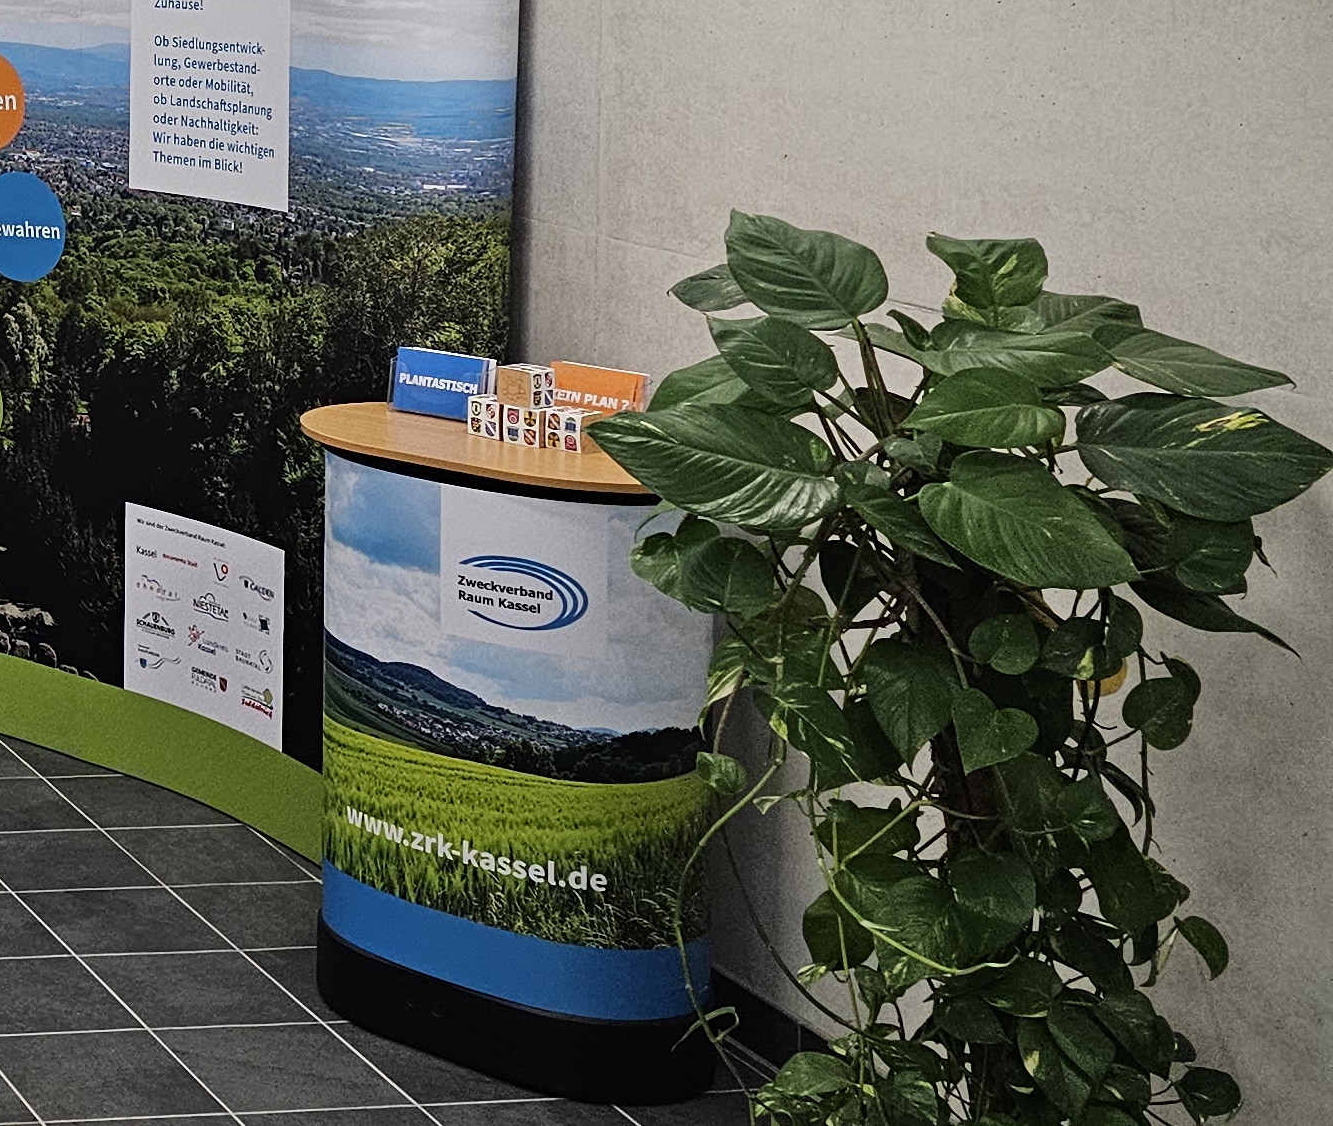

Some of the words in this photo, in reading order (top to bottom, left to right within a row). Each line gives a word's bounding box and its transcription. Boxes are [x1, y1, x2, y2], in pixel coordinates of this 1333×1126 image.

[154, 35, 170, 48] Ob
[171, 36, 266, 55] Siedlungsentwick-
[154, 54, 182, 70] lung,
[183, 57, 261, 74] Gewerbestand-
[153, 75, 176, 87] orte
[178, 76, 203, 89] oder
[205, 78, 254, 96] Mobilität,
[153, 93, 167, 105] ob
[170, 95, 273, 120] Landschaftsplanung
[153, 113, 179, 126] oder
[180, 115, 260, 136] Nachhaltigkeit:
[152, 131, 171, 145] Wir
[173, 133, 206, 149] haben
[208, 137, 225, 151] die
[227, 139, 276, 159] wichtigen
[152, 150, 196, 167] Themen
[198, 156, 212, 169] im
[214, 157, 244, 174] Blick!
[398, 372, 479, 395] PLANTASTISCH
[583, 393, 619, 411] PLAN
[457, 575, 555, 601] Zweckverband
[457, 590, 495, 607] Raum
[497, 596, 542, 615] Kassel
[346, 804, 609, 892] www.zrk-kassel.de
